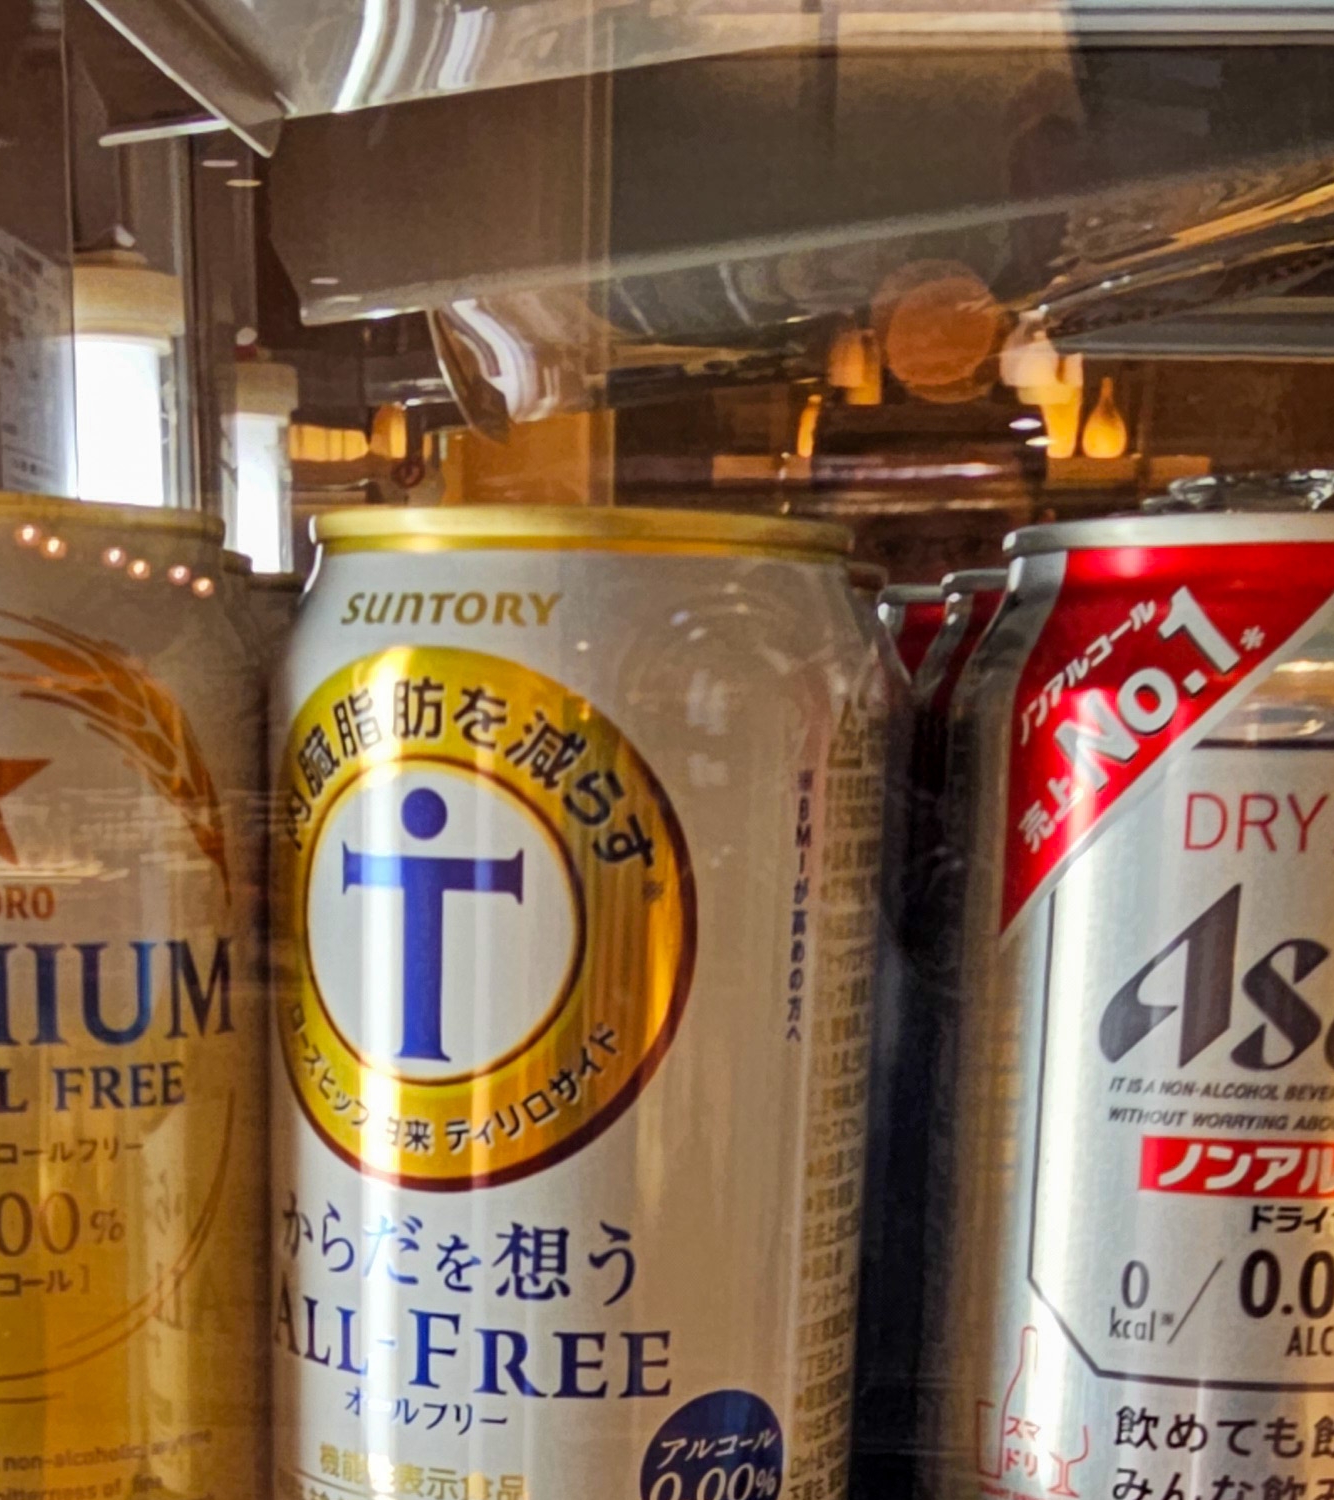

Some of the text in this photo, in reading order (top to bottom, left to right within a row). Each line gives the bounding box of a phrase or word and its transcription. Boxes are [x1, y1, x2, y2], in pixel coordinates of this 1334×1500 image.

[341, 589, 563, 628] SUNTORY
[54, 1060, 186, 1112] FREE
[1159, 1080, 1279, 1101] NON-ALCOHOL
[1107, 1107, 1187, 1127] WITHOUT
[1192, 1111, 1289, 1131] WORRYING
[345, 1387, 509, 1437] オルフリー
[657, 1427, 776, 1471] アルコール
